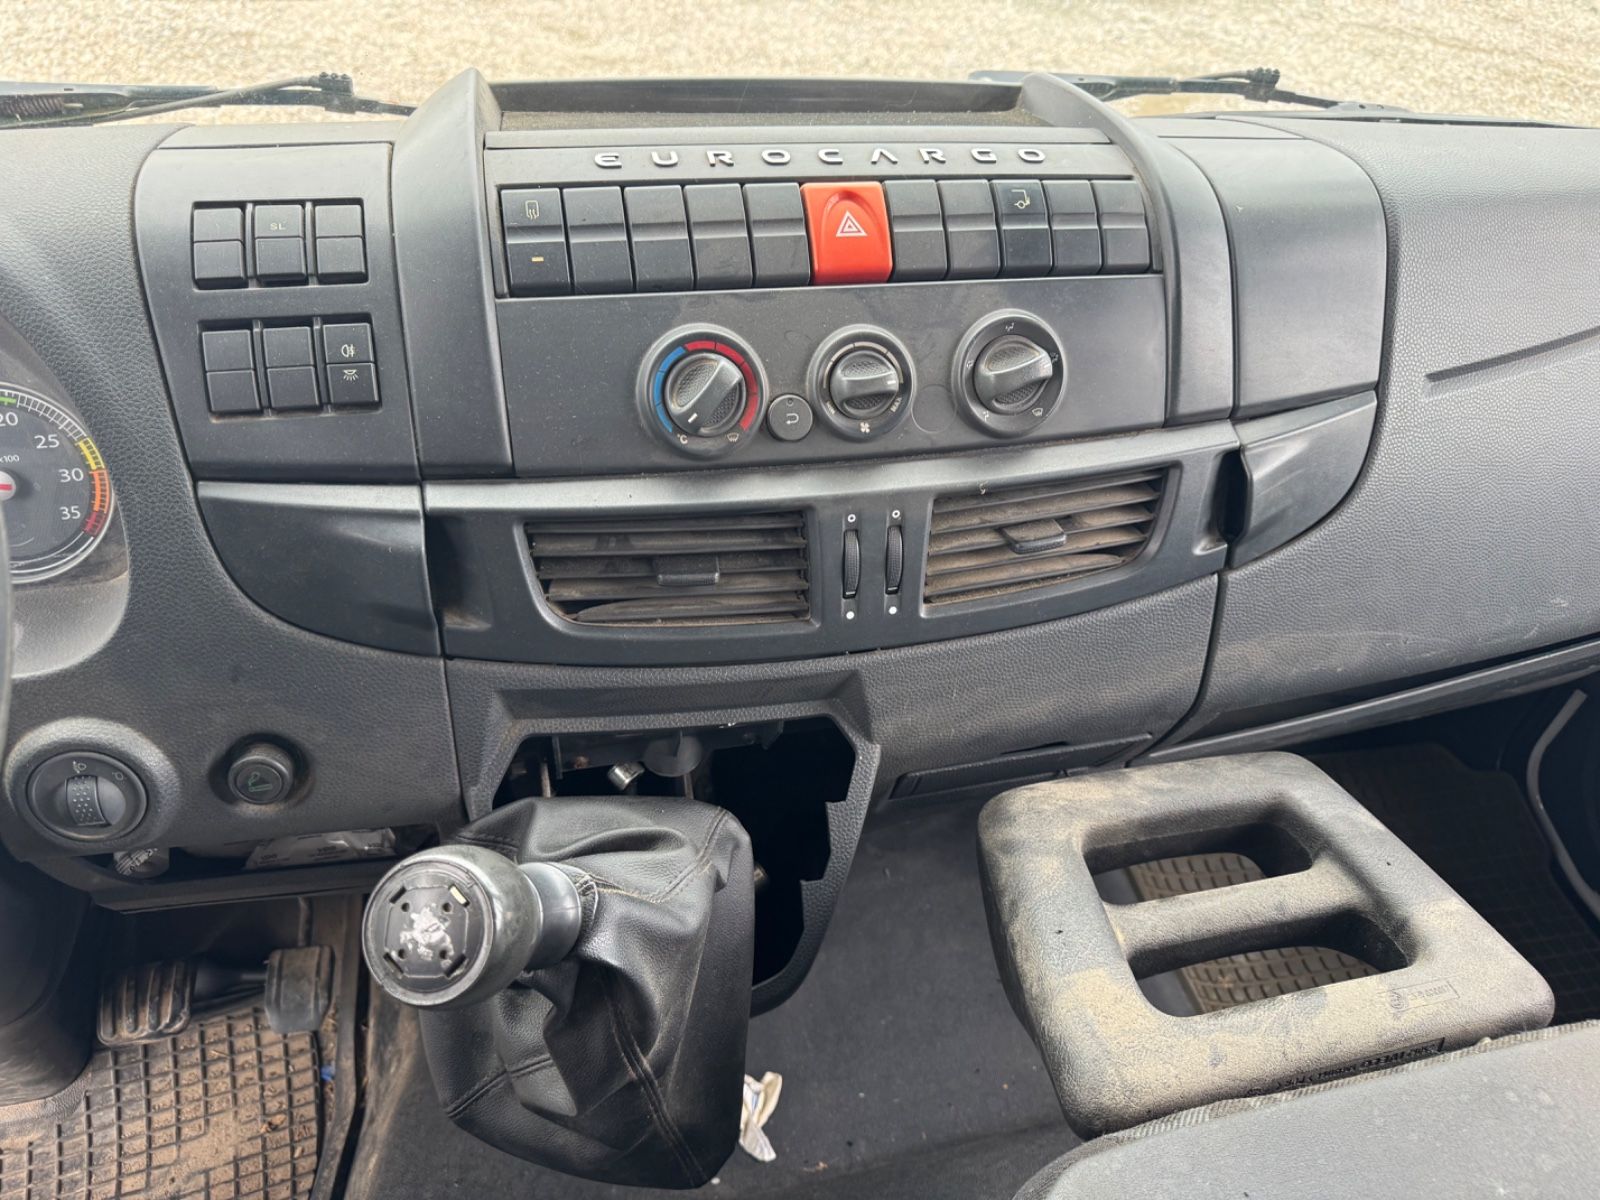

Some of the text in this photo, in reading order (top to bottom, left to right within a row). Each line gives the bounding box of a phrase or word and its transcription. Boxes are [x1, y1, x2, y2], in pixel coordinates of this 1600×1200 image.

[594, 147, 1047, 169] EUROCARGO
[270, 222, 286, 231] SL
[34, 434, 60, 449] 25
[58, 467, 84, 483] 30
[59, 506, 81, 521] 35
